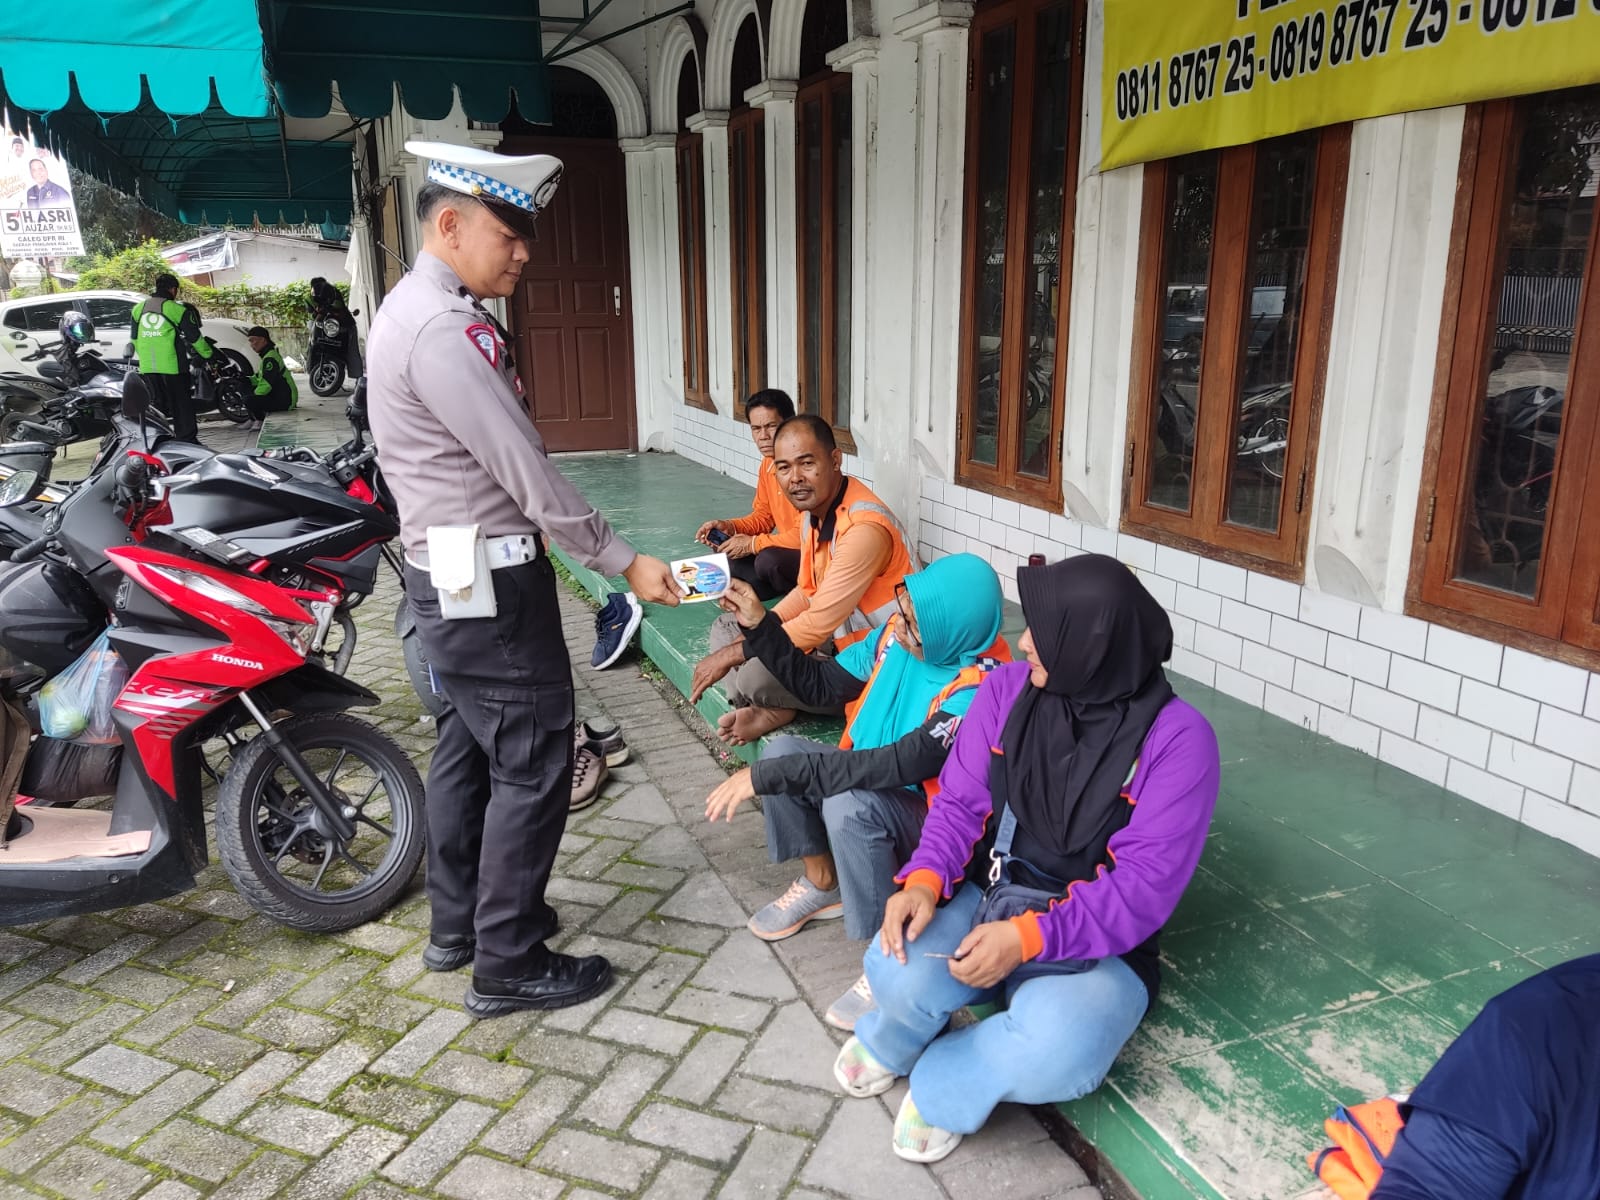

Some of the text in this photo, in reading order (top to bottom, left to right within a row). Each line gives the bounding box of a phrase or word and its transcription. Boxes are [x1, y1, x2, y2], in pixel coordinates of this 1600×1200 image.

[1116, 61, 1160, 120] 0811
[1168, 45, 1221, 108] 8767
[1329, 0, 1399, 66] 8767
[1404, 0, 1448, 48] 25
[6, 212, 20, 231] 5
[38, 210, 71, 223] ASRI
[211, 653, 264, 671] HONDA
